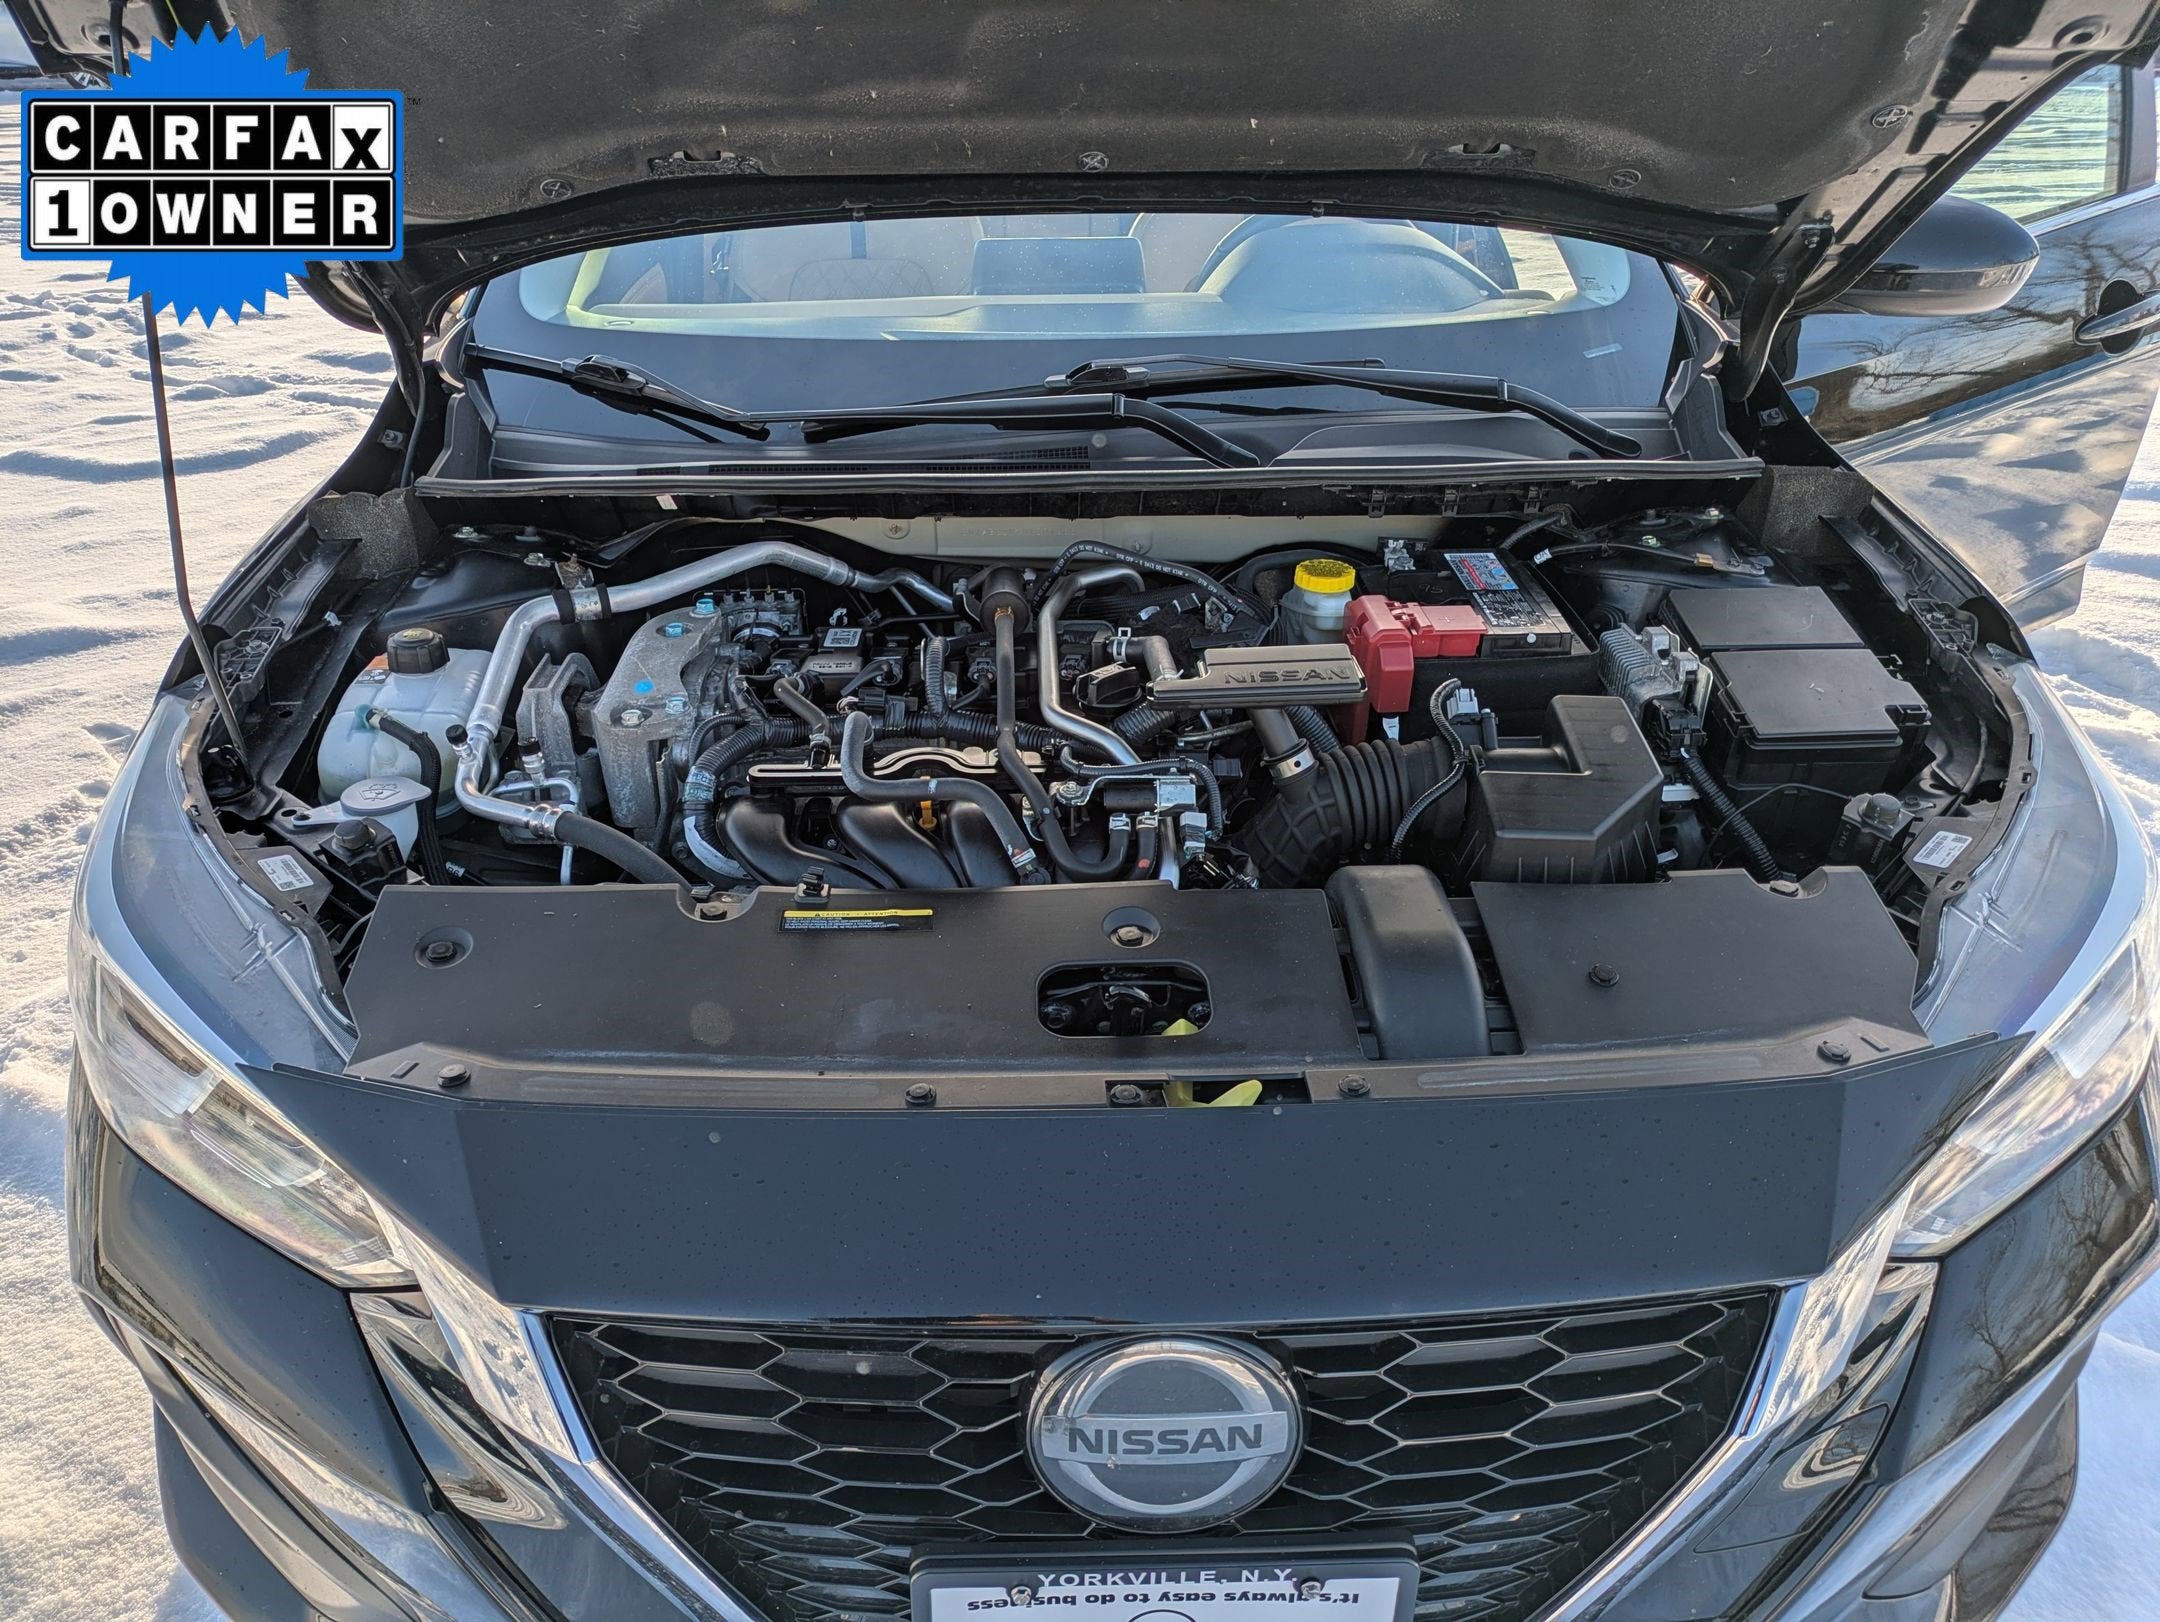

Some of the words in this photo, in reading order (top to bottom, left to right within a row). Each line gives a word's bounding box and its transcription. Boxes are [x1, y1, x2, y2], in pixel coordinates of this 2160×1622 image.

[1225, 666, 1350, 684] NISSAN
[1068, 1423, 1263, 1455] NISSAN
[1241, 1568, 1298, 1584] N.Y.
[1085, 1594, 1115, 1605] do
[1123, 1593, 1150, 1604] to
[1158, 1591, 1217, 1603] easy
